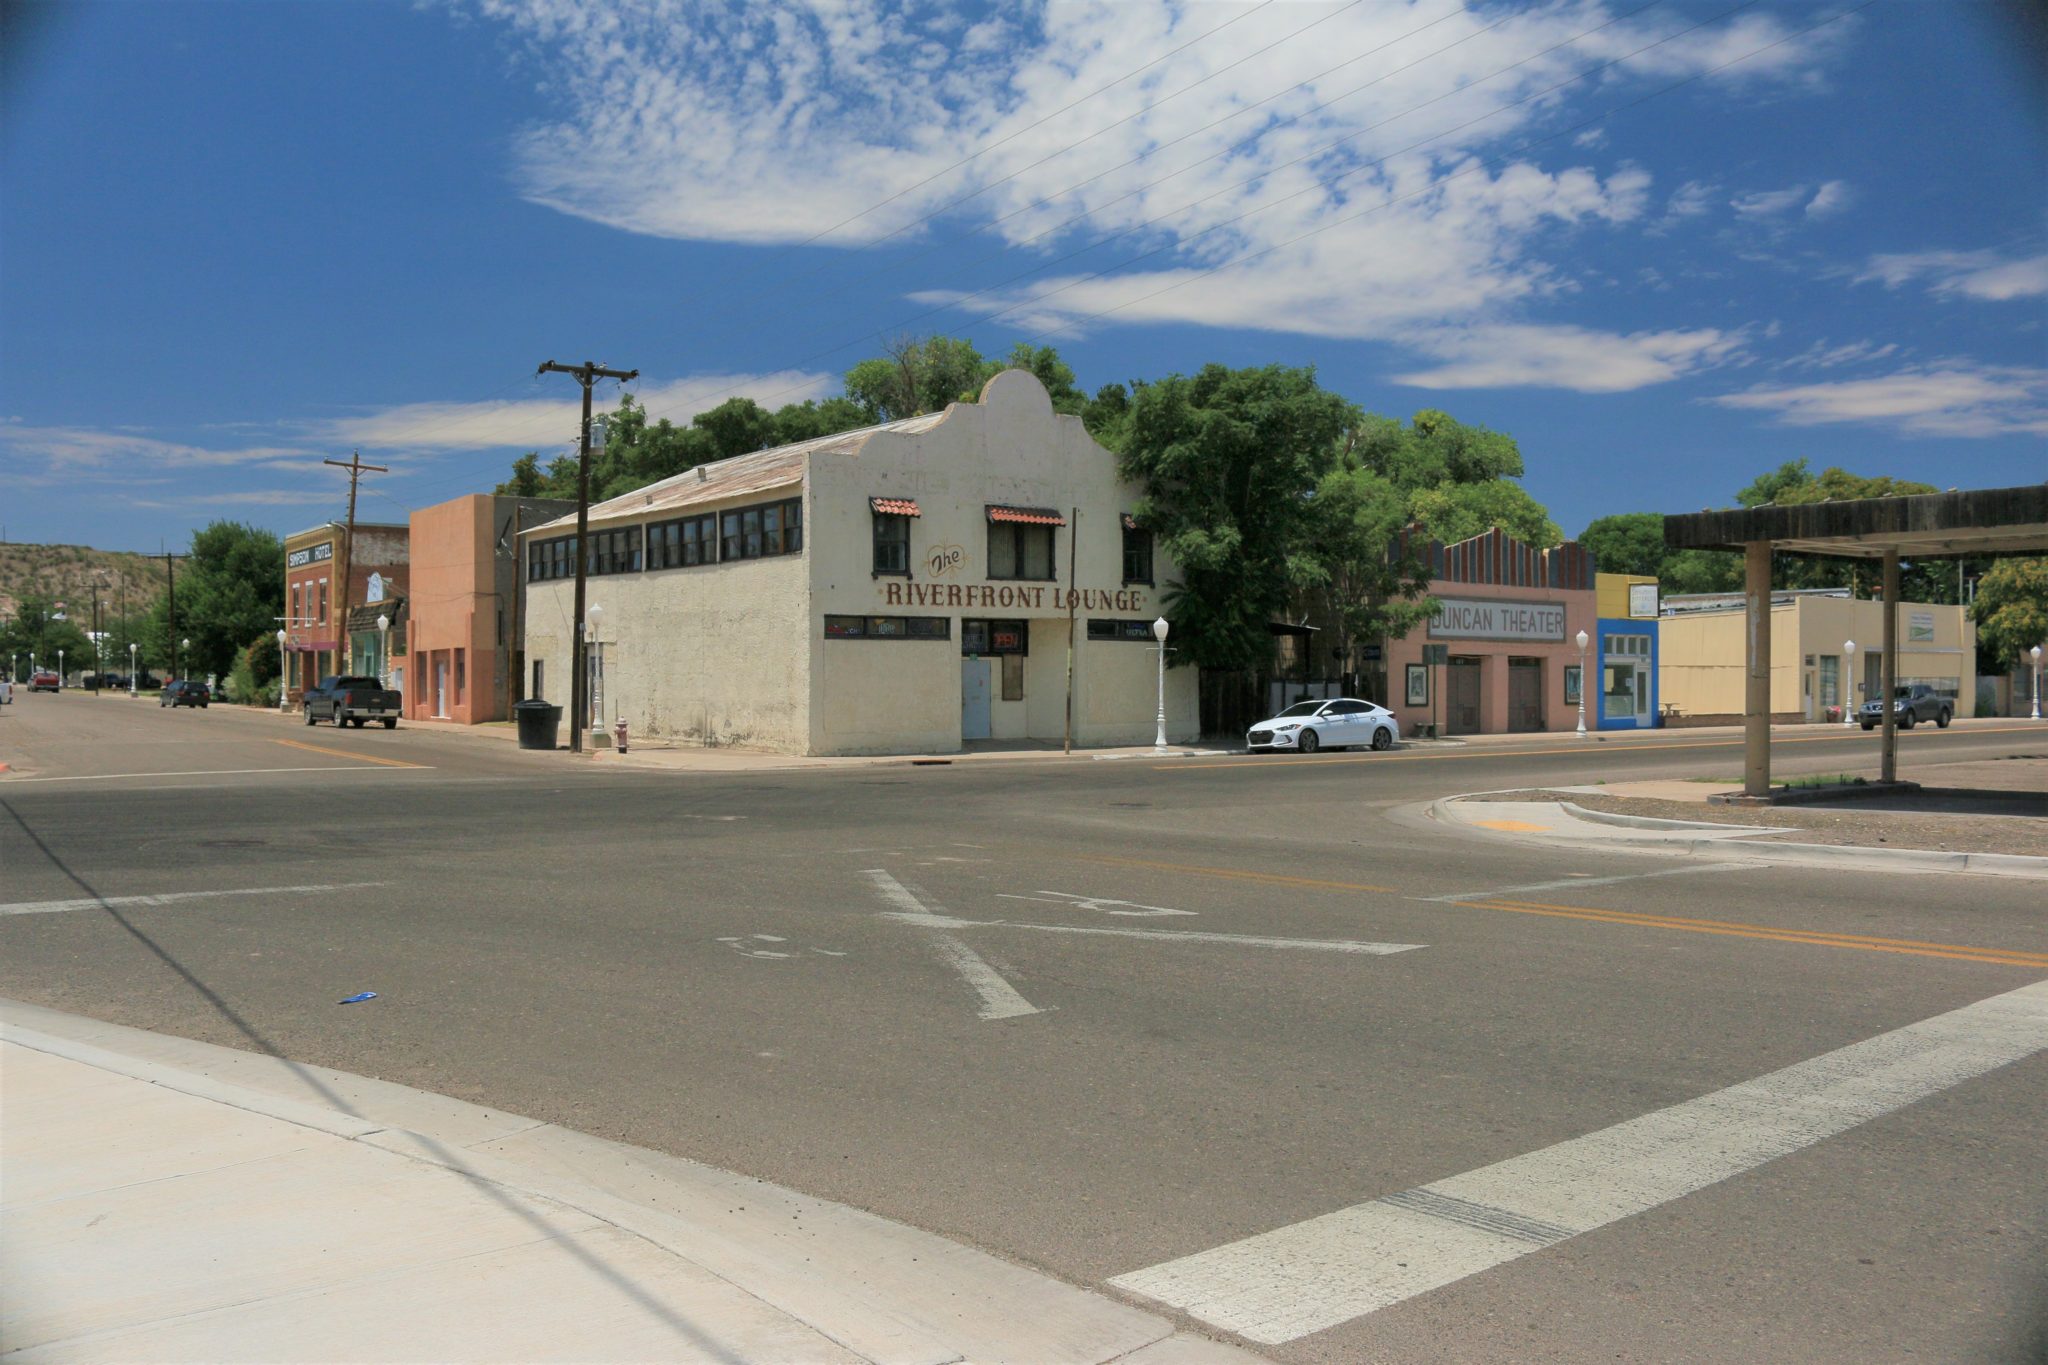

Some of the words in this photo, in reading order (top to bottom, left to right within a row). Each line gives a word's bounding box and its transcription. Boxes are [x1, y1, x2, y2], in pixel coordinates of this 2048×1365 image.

[289, 550, 309, 567] SIMPSON
[315, 544, 332, 560] HOTEL
[931, 551, 960, 573] The
[886, 583, 1045, 608] RIVERFRONT
[1053, 587, 1142, 612] LOUNGE
[1431, 606, 1493, 631] DUNCAN
[1500, 608, 1564, 634] THEATER
